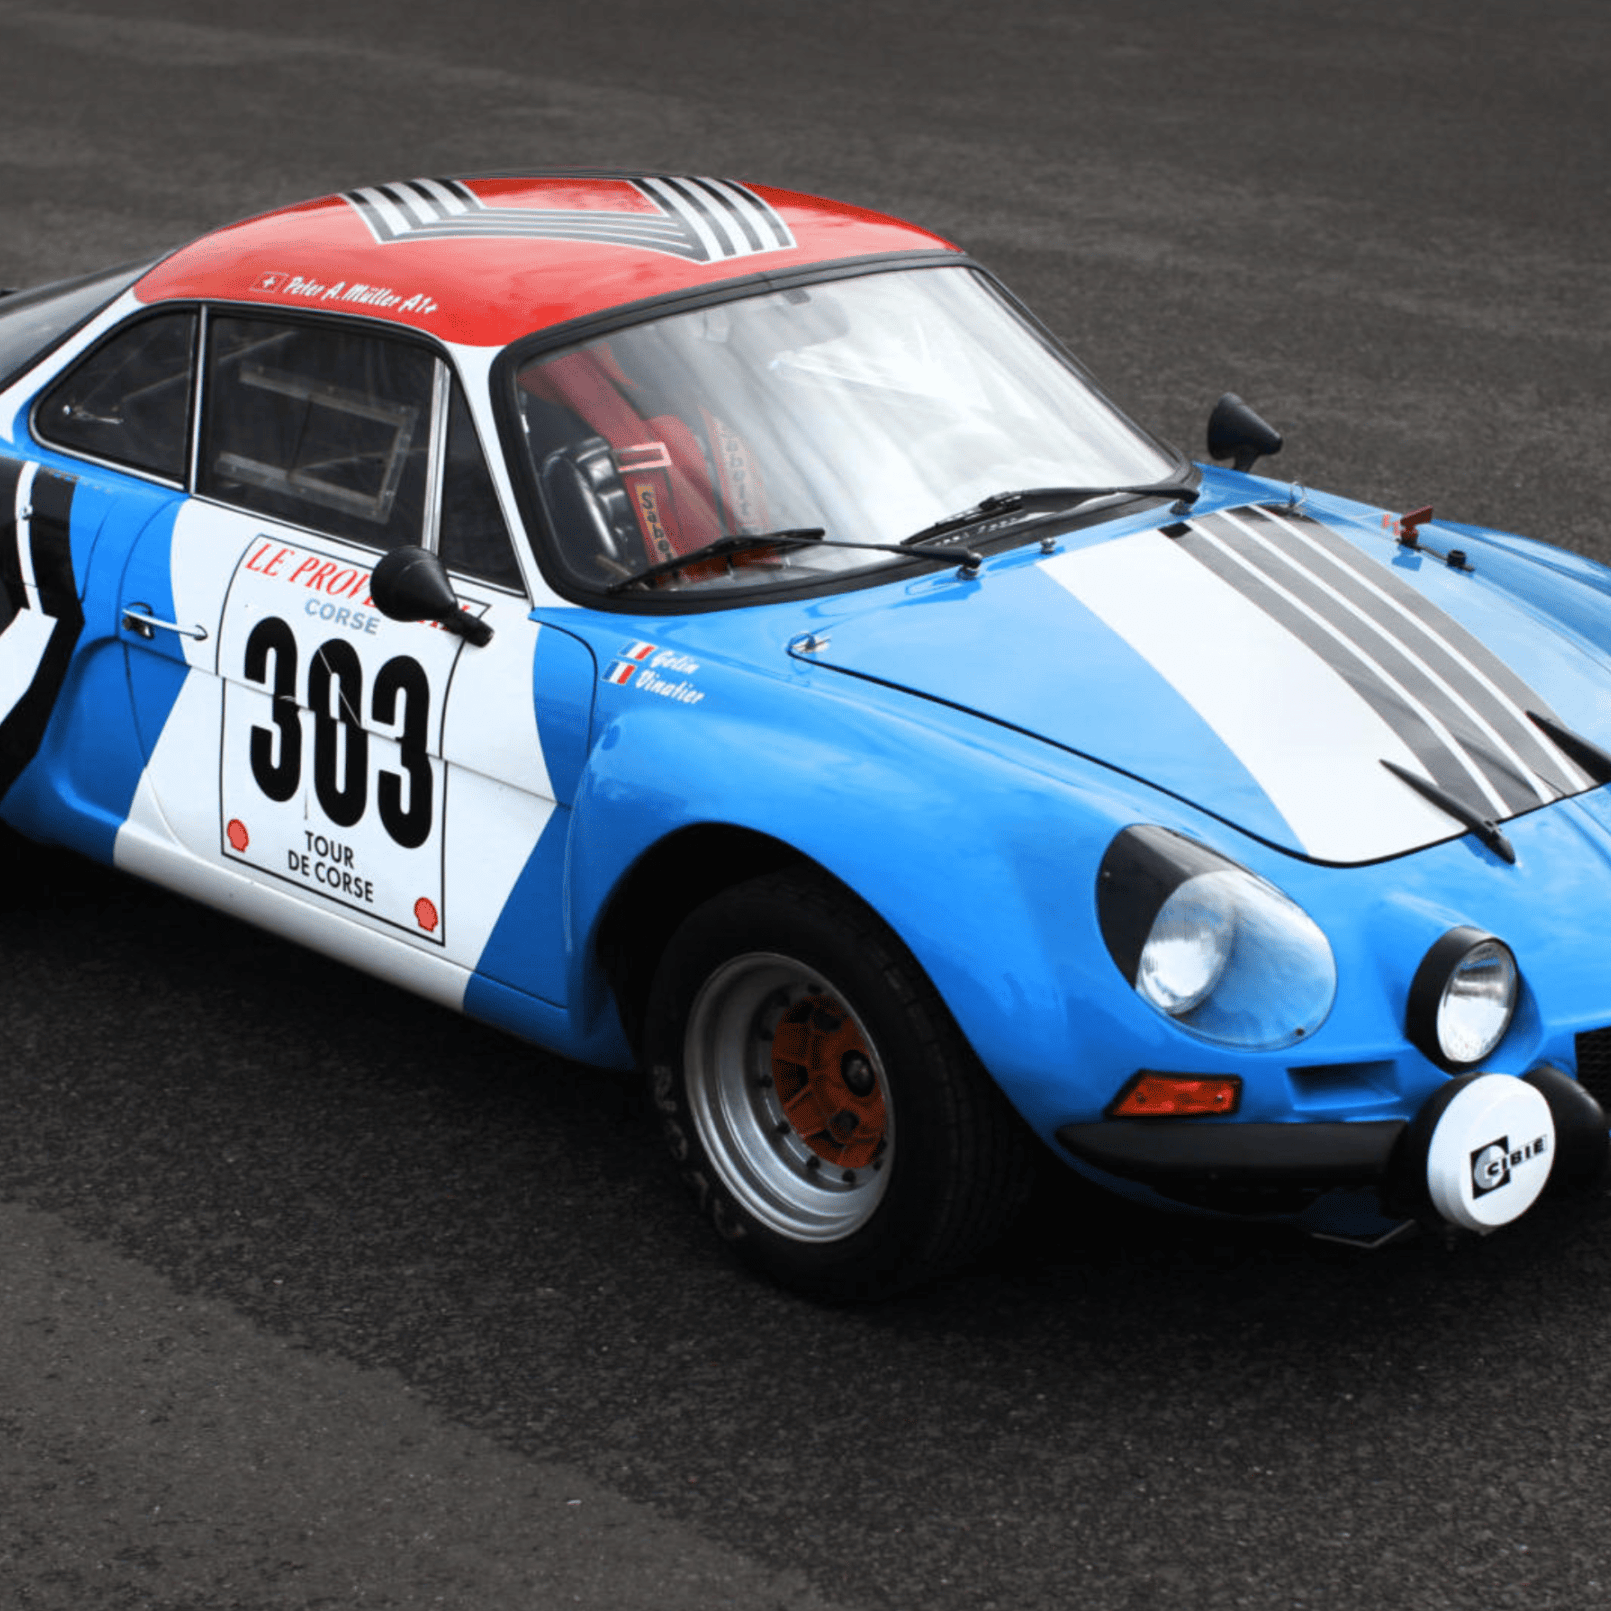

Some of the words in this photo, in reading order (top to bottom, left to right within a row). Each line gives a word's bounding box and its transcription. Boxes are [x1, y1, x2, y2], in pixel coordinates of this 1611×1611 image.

[283, 276, 325, 296] Peter
[245, 543, 295, 577] LE
[304, 598, 381, 636] CORSE
[244, 616, 433, 849] 303
[305, 830, 354, 870] TOUR
[288, 849, 310, 877] DE
[315, 861, 374, 903] CORSE
[1486, 1137, 1545, 1177] CIBIE
